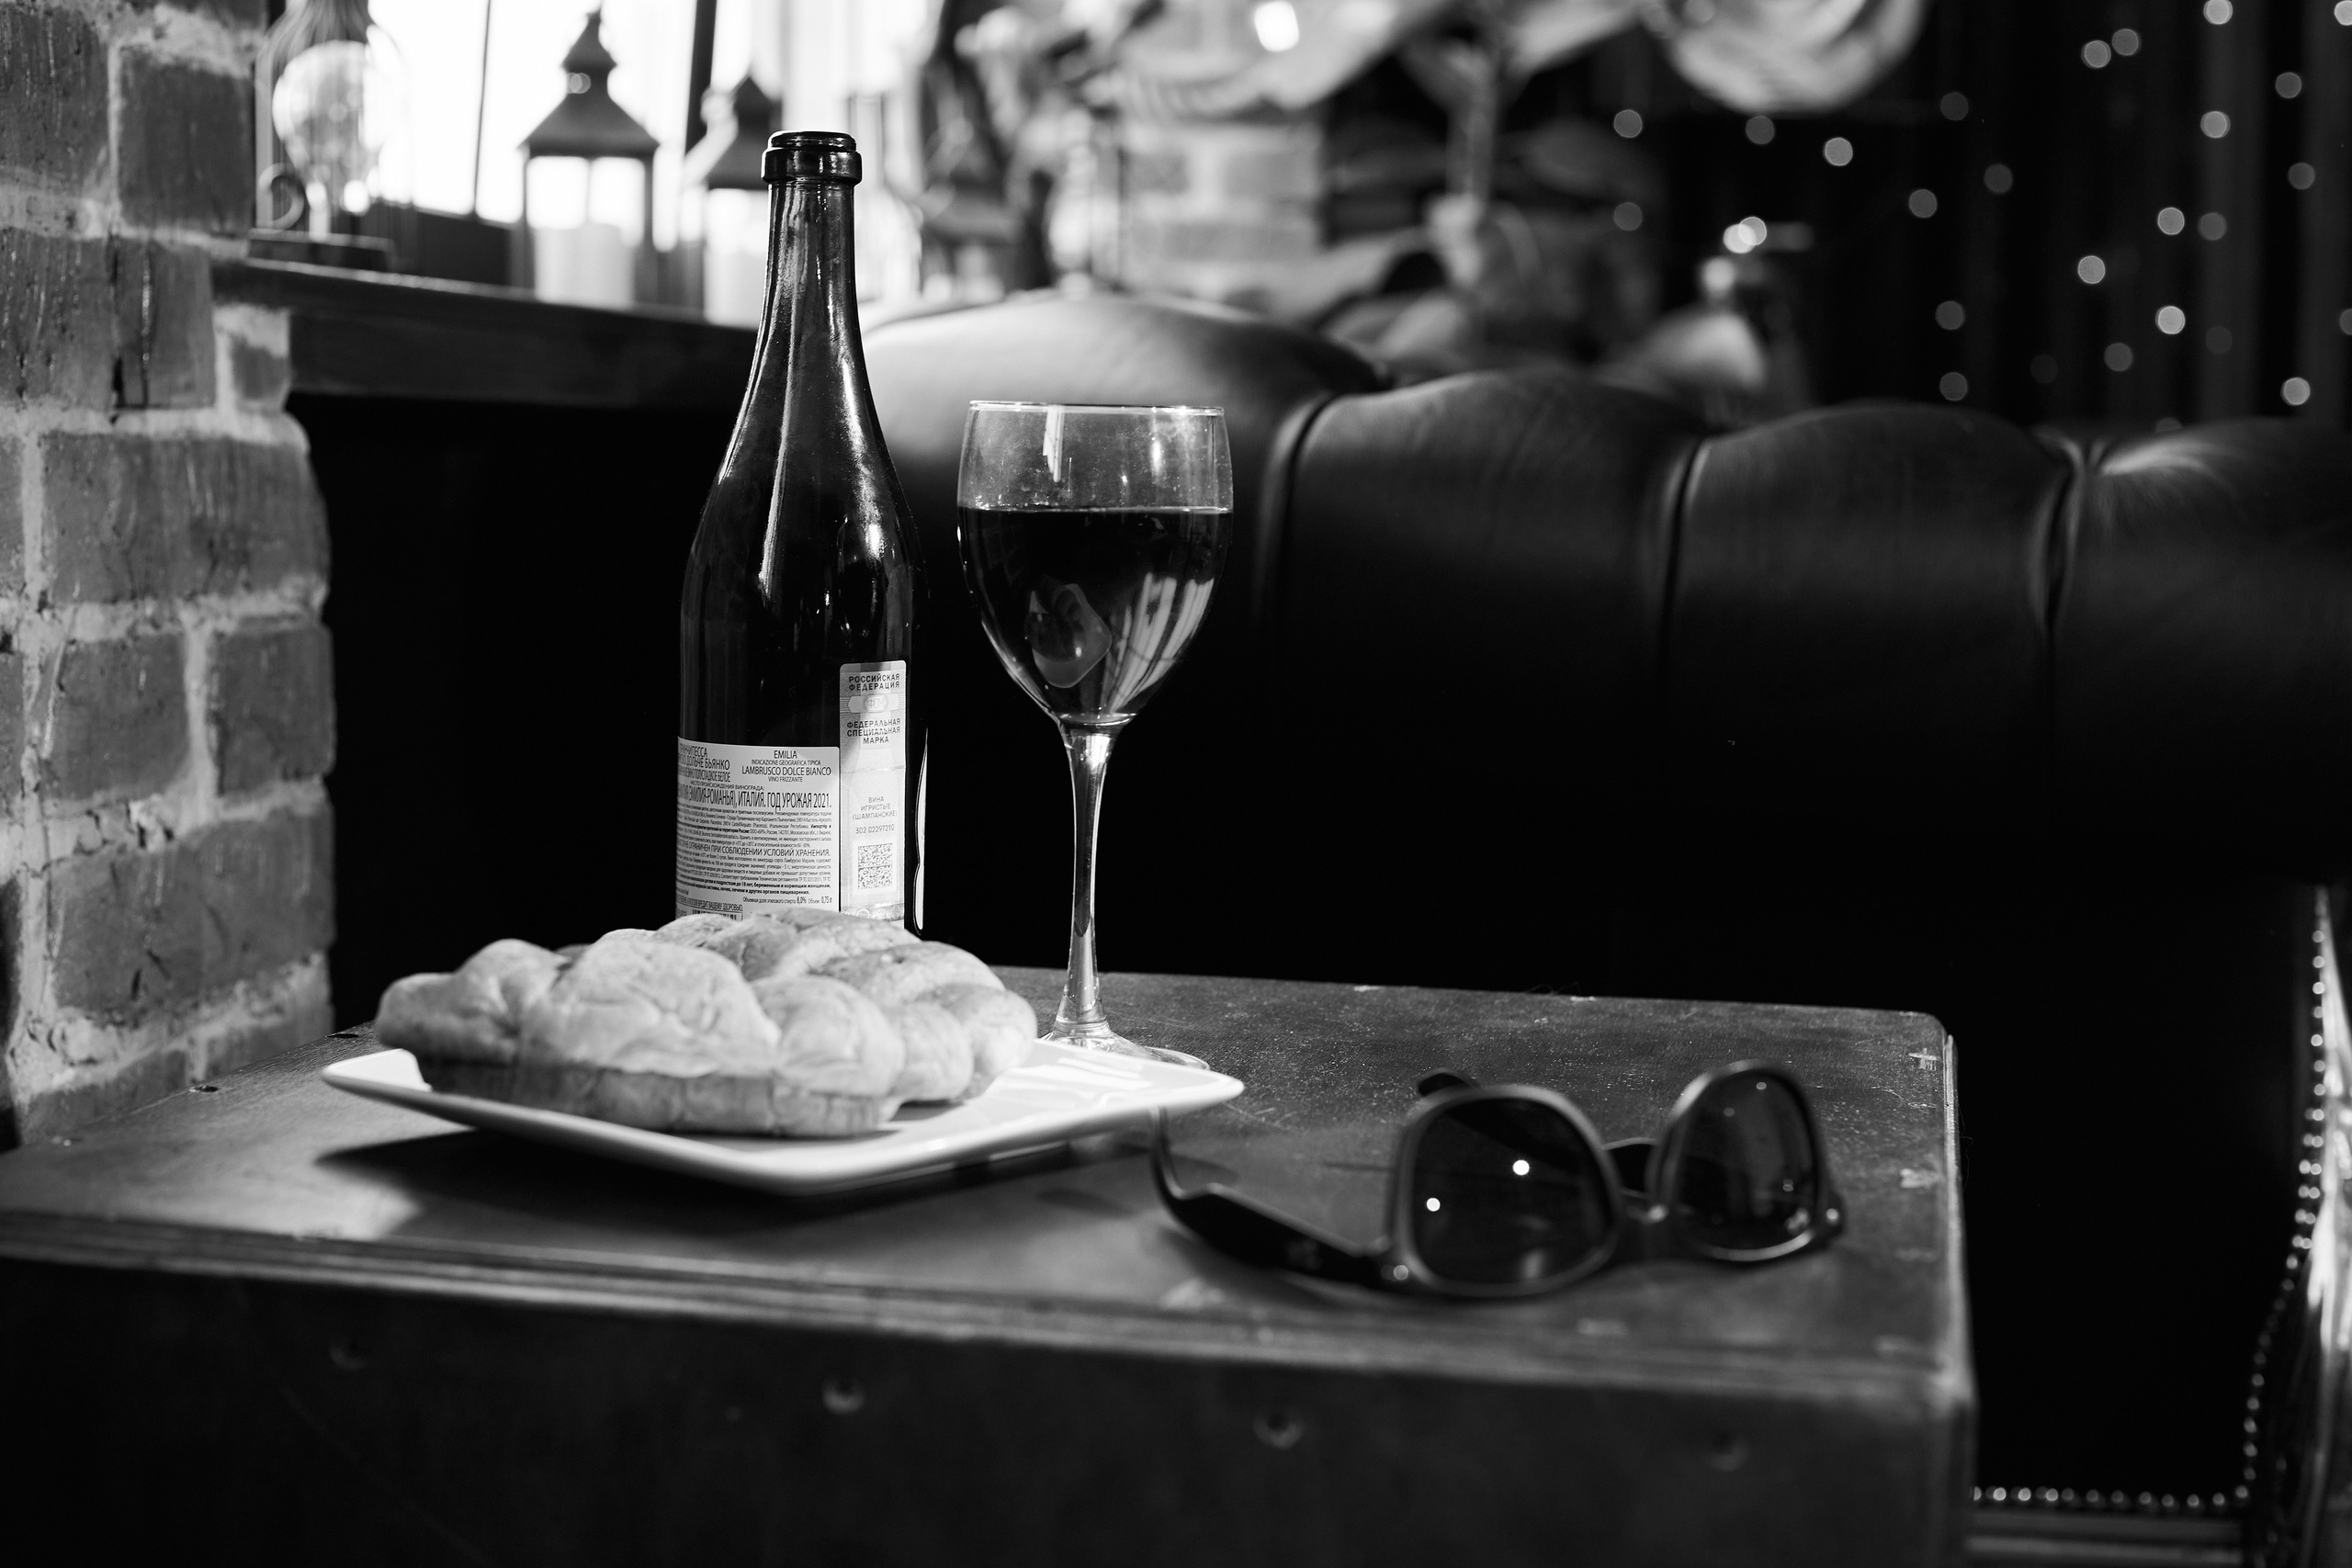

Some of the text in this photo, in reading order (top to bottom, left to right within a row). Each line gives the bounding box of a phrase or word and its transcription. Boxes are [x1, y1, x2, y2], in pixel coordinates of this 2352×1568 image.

[848, 673, 900, 683] РОССИЙСКАЯ
[848, 681, 900, 692] ФЕДЕРАЦИЯ
[846, 718, 900, 728] ФЕДЕРАЛЬНАЯ
[846, 727, 900, 737] СПЕЦИАЛЬНАЯ
[774, 750, 797, 759] EMILIA
[705, 758, 730, 771] БЬЯНКО
[741, 766, 831, 775] LAMBRUSCO DOLCE BIANCO
[738, 791, 766, 807] ИТАЛИЯ.
[767, 792, 781, 812] ГОД
[782, 793, 812, 808] УРОЖАЯ
[813, 793, 831, 808] 2021.
[861, 803, 891, 811] ИГРИСТЫЕ
[853, 810, 898, 820] (ШАМПАНСКИЕ)
[711, 844, 721, 852] ПРИ
[722, 846, 763, 855] СОБЛЮДЕНИИ
[763, 847, 795, 856] УСЛОВИЙ
[797, 896, 807, 905] 8,0%
